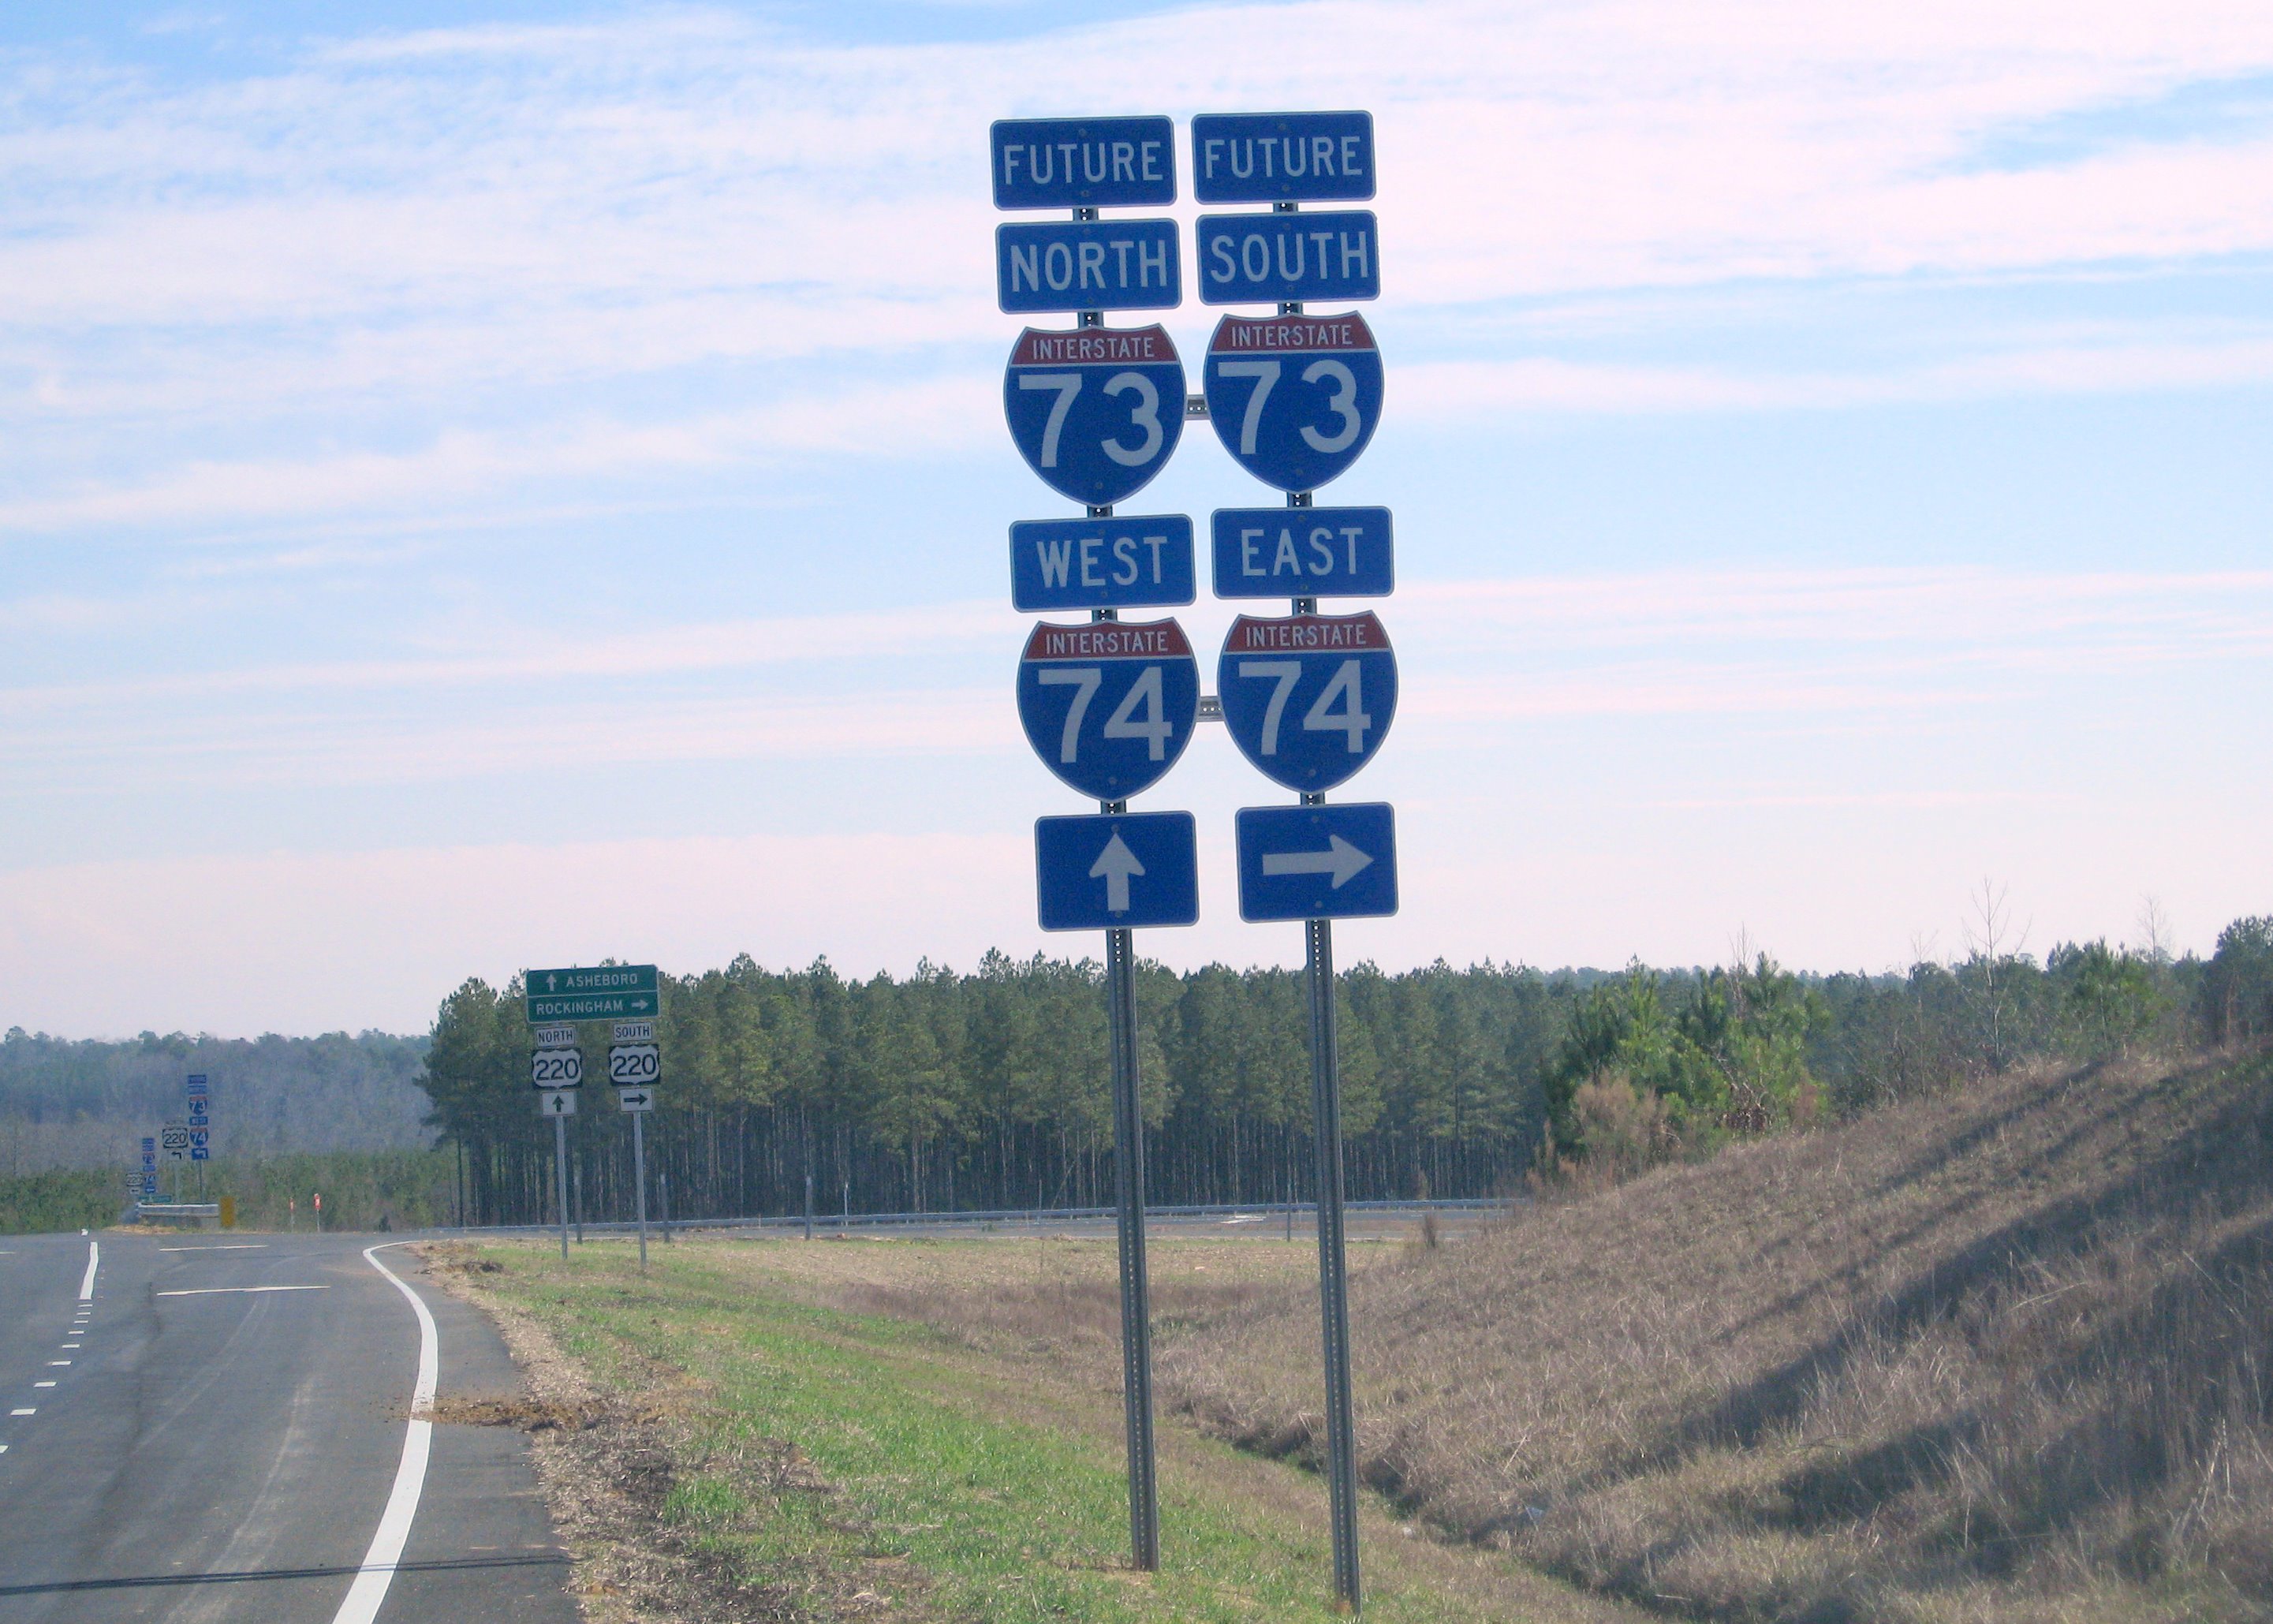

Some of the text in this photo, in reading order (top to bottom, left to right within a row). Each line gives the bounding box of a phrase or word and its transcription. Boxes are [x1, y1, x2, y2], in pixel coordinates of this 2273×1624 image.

[1004, 141, 1163, 185] FUTURE
[1205, 136, 1362, 178] FUTURE
[1010, 240, 1167, 292] NORTH
[1211, 231, 1368, 283] SOUTH
[1232, 324, 1353, 346] INTERSTATE
[1033, 338, 1154, 360] INTERSTATE
[1218, 360, 1362, 455] 73
[1019, 372, 1164, 468] 73
[1036, 536, 1167, 588] WEST
[1241, 528, 1363, 576] EAST
[1046, 631, 1168, 655] INTERSTATE
[1246, 625, 1366, 647] INTERSTATE
[1039, 666, 1172, 763] 74
[1238, 660, 1371, 755] 74
[566, 973, 637, 987] ASHEBORO
[536, 999, 623, 1015] ROCKINGHAM
[539, 1030, 573, 1043] NORTH
[615, 1026, 650, 1038] SOUTH
[536, 1058, 579, 1081] 220
[613, 1054, 656, 1077] 220
[190, 1101, 205, 1111] 73
[164, 1133, 186, 1144] 220
[192, 1133, 205, 1143] 74
